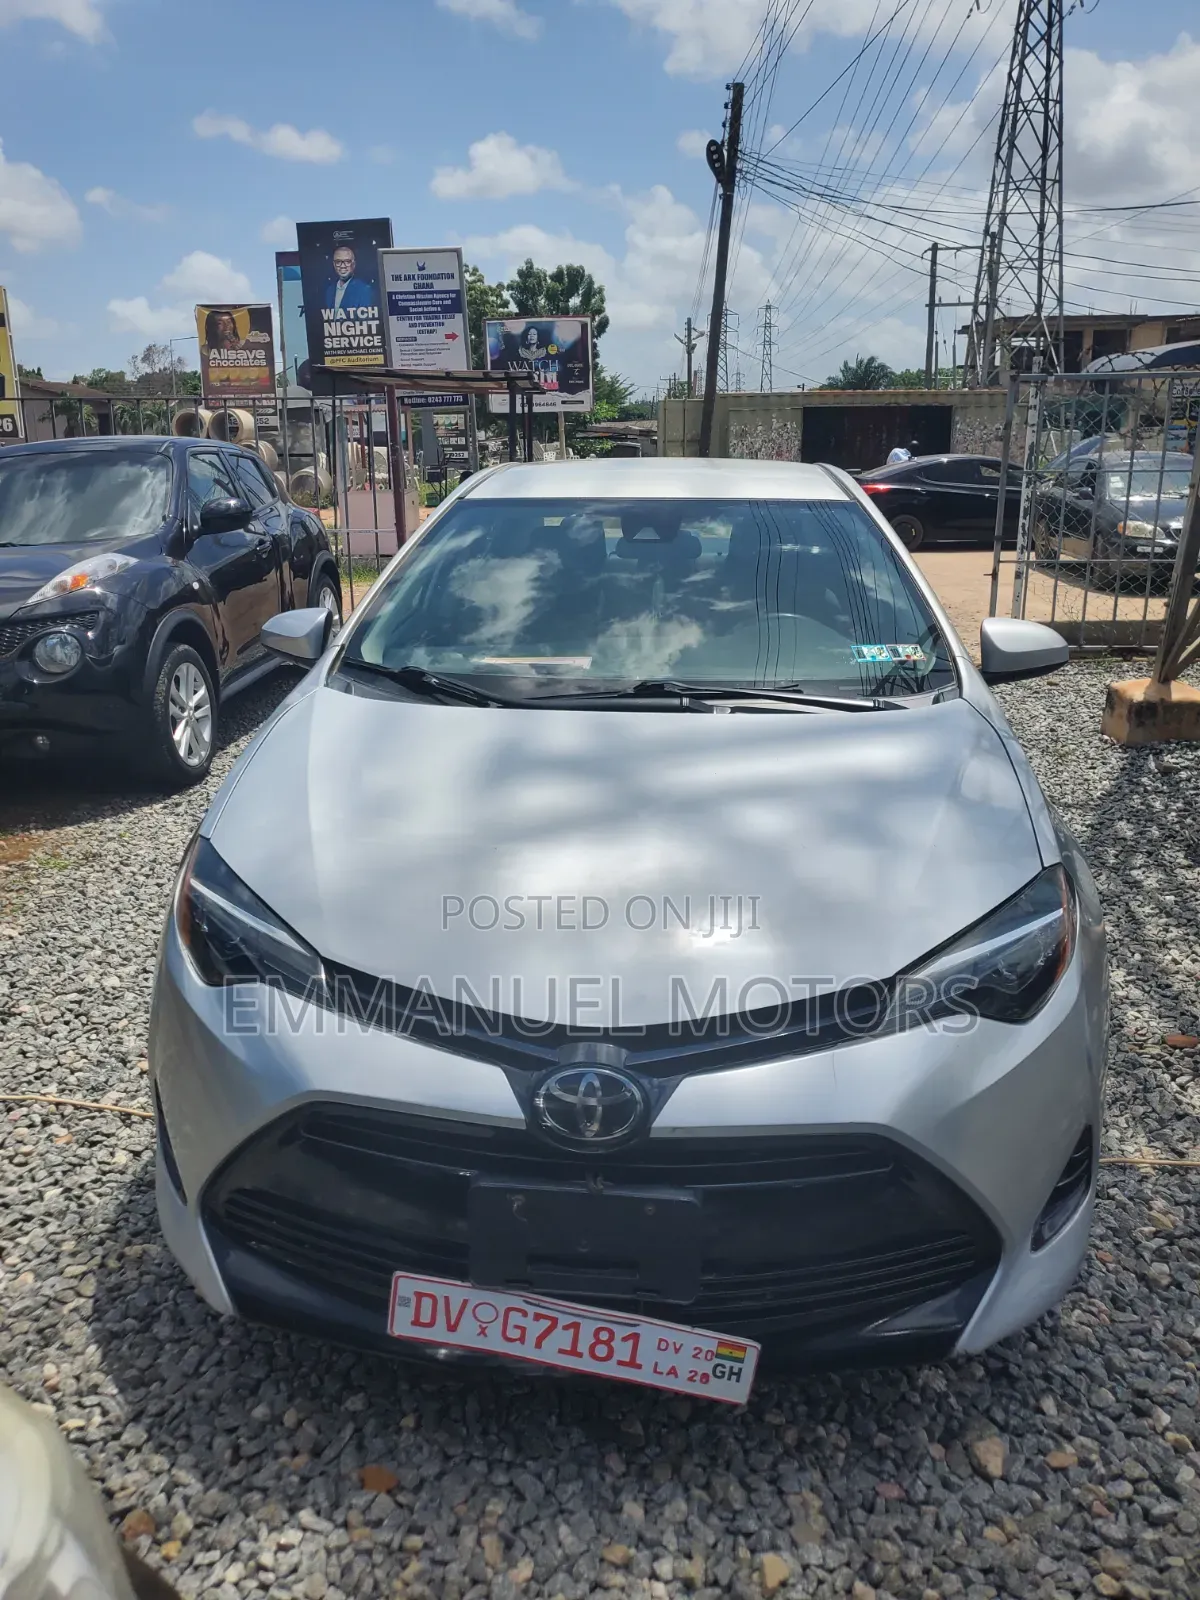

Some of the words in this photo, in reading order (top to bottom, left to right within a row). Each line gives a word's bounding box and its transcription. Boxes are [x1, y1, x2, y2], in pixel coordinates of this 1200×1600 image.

[404, 273, 416, 281] ARK
[417, 272, 455, 280] FOUNDATION
[321, 306, 379, 320] WATCH
[323, 320, 379, 336] NIGHT
[324, 336, 382, 348] SERVICE
[209, 348, 266, 360] Allsave
[209, 358, 267, 367] chocolates
[508, 360, 560, 371] WATCH
[427, 395, 442, 403] 0243
[410, 1290, 470, 1333] DV
[501, 1306, 643, 1370] G7181
[656, 1337, 684, 1355] DV
[691, 1346, 715, 1362] 20
[652, 1361, 679, 1379] LA
[711, 1363, 743, 1384] GH
